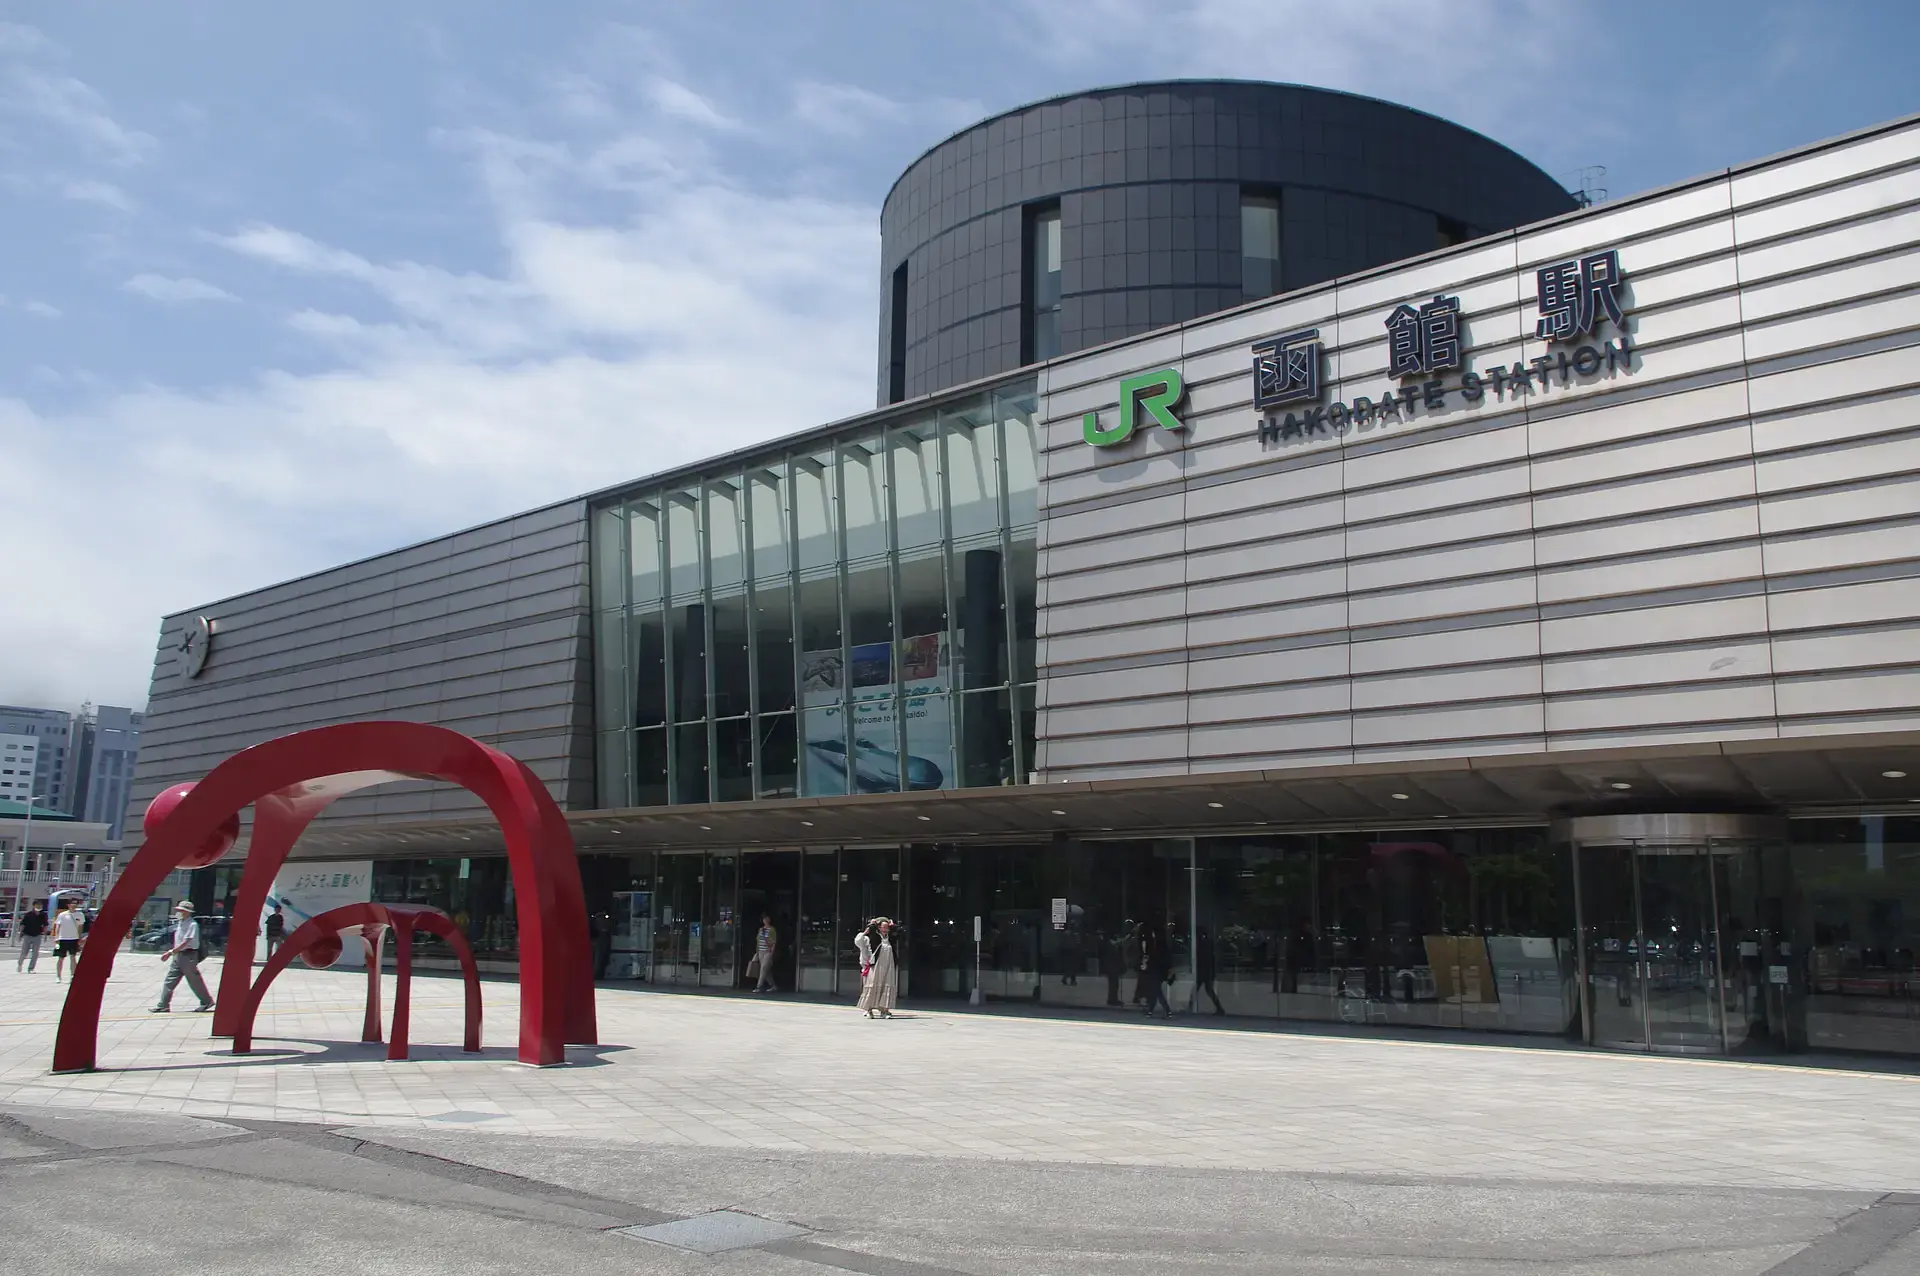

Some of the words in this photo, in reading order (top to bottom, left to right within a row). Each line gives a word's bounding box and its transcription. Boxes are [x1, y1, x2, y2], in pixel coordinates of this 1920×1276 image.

[1252, 249, 1625, 412] 函館駅
[1083, 368, 1184, 447] JR
[1257, 380, 1445, 444] HAKODATE
[1460, 337, 1632, 401] STATION
